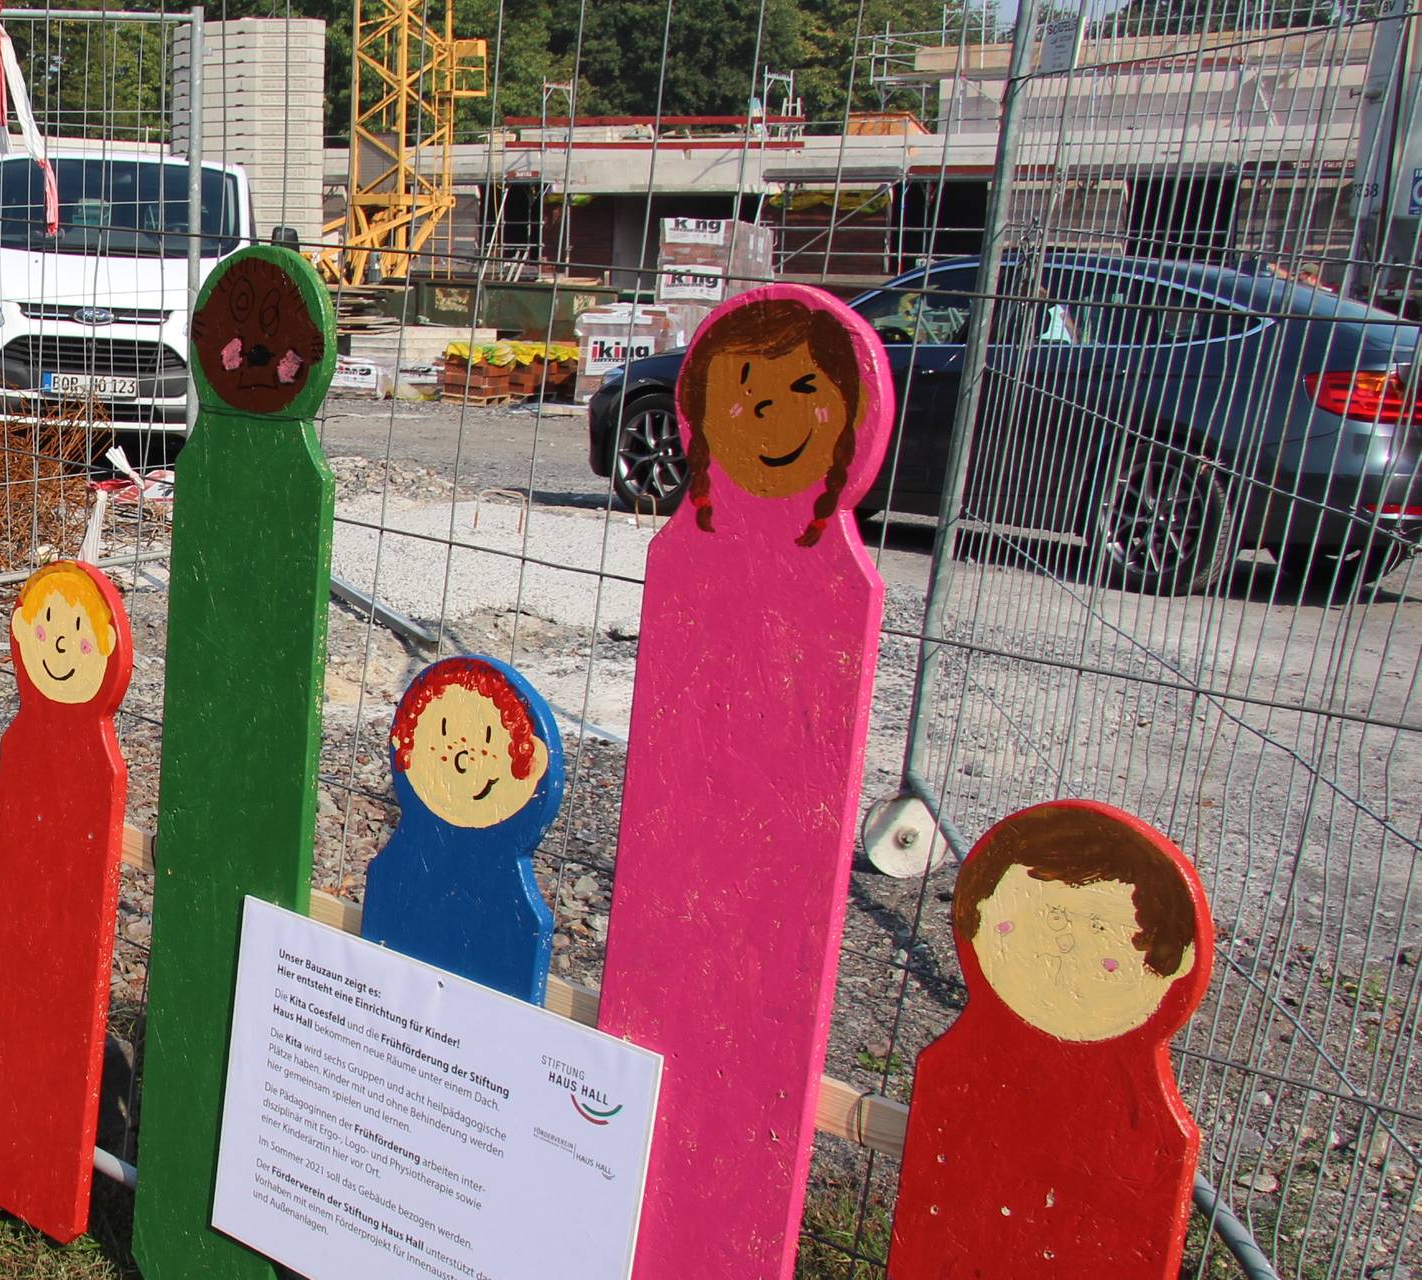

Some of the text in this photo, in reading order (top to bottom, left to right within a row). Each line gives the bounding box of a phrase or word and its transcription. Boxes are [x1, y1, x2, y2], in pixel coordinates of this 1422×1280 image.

[113, 379, 136, 394] 123
[277, 964, 460, 1048] Hier entsteht eine Einrichtung für Kinder!
[279, 948, 381, 998] Unser Bauzaun zeigt es:
[270, 1027, 507, 1142] Die Kita wird sechs Gruppen und acht heilpädagogische
[273, 1003, 500, 1112] Haus Hall bekommen neue Räume unter einem Dach.
[274, 988, 510, 1099] Die Kita Coesfeld und die Frühförderung der Stiftung
[541, 1054, 585, 1081] STIFTUNG
[267, 1058, 411, 1133] hier gemeinsam spielen und lernen.
[268, 1042, 504, 1158] Plätze haben. Kinder mit und ohne Behinderung werden
[548, 1071, 609, 1106] HAUS HALL
[261, 1114, 381, 1179] einer Kinderärztin hier vor Ort.
[263, 1098, 482, 1210] disziplinär mit Ergo-, Logo- und Physiotherapie sowie
[264, 1081, 486, 1193] Die Pädagoginnen der Frühförderung arbeiten inter-
[576, 1152, 612, 1175] HAUS HALL
[253, 1189, 329, 1236] und Außenanlagen.
[254, 1173, 292, 1200] Vorhaben
[293, 1195, 307, 1207] mit
[308, 1201, 333, 1221] einem
[335, 1214, 392, 1251] Förderprojekt
[393, 1244, 405, 1258] für
[256, 1158, 492, 1280] Der Förderverein der Stiftung Haus Hall unterstützt da
[258, 1135, 473, 1251] Im Sommer 2021 soll das Gebäude bezogen werden.
